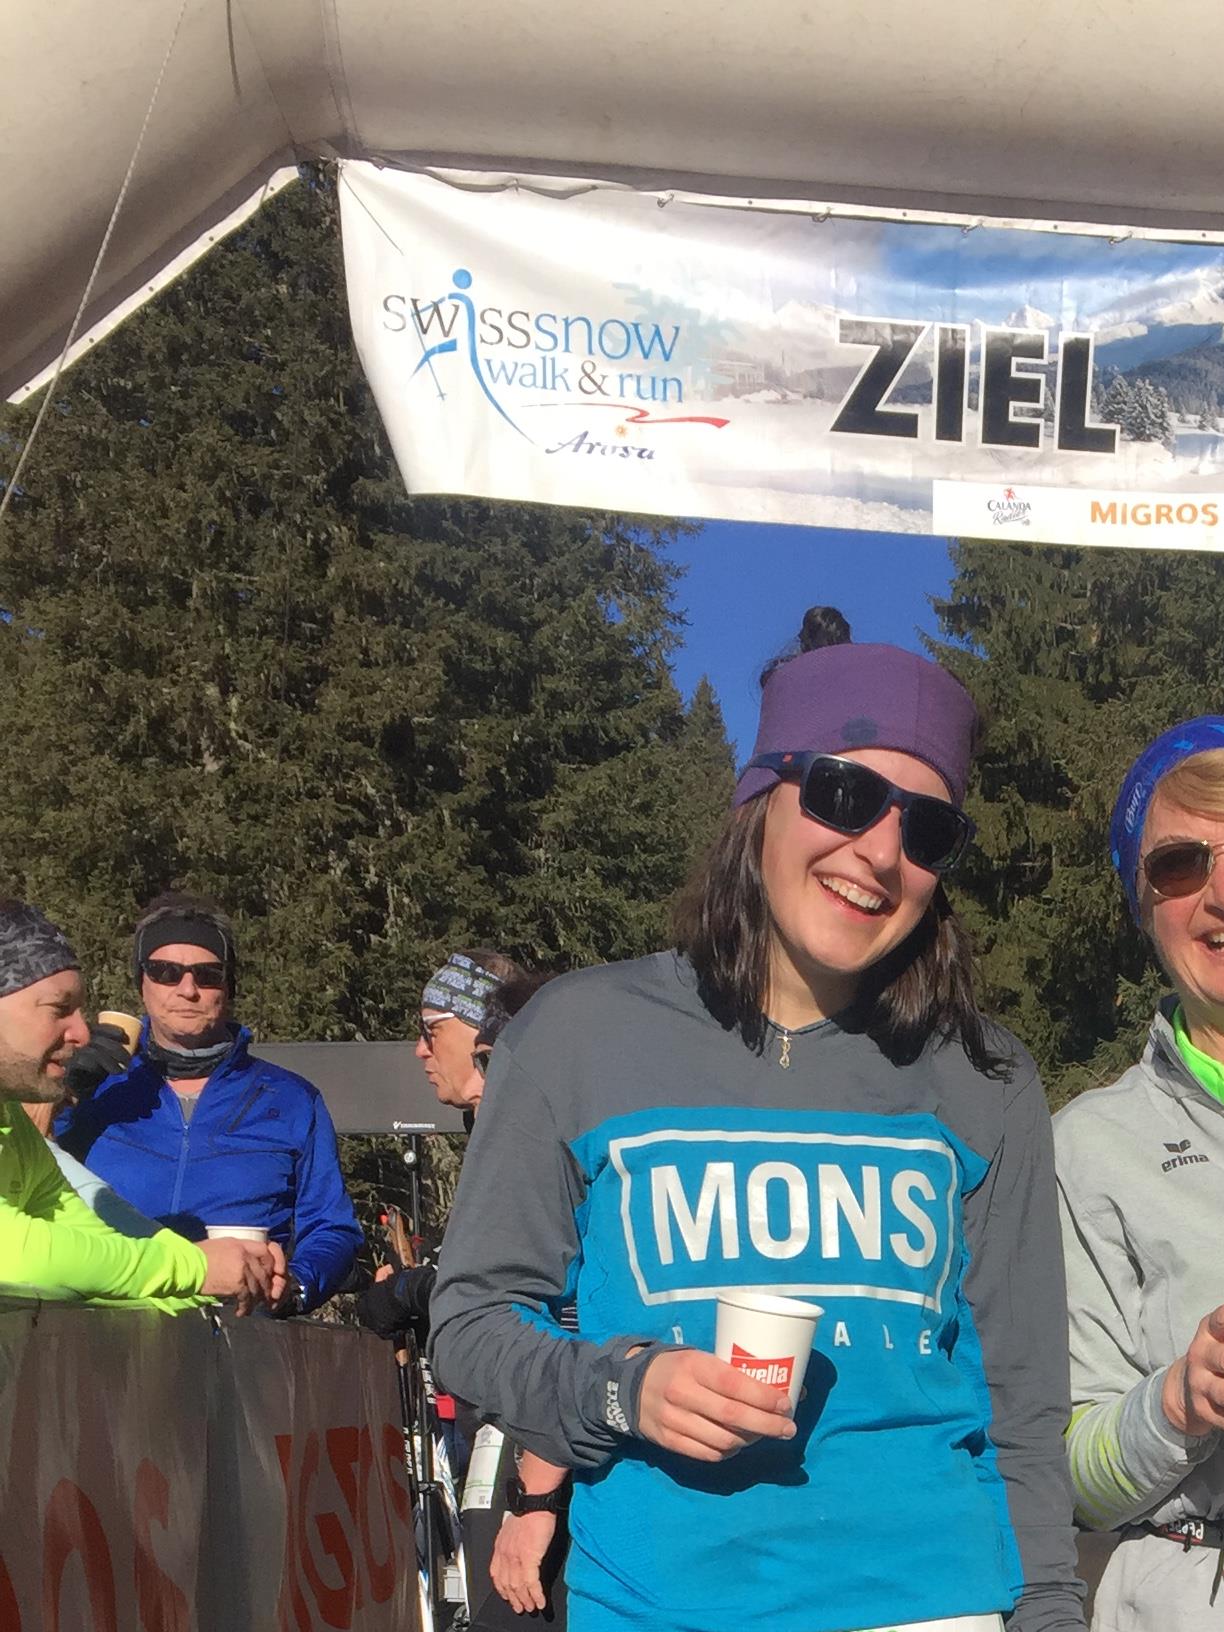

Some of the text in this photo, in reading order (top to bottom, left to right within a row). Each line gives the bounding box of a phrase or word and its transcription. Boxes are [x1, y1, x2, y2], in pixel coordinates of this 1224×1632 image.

[483, 354, 684, 403] walk & run
[829, 315, 1121, 454] ZIEL
[545, 430, 656, 461] Arosa
[987, 499, 1031, 511] CALANDA
[1090, 501, 1219, 527] MIGROS
[1161, 1154, 1210, 1172] erima
[651, 1161, 937, 1269] MONS
[738, 1363, 789, 1385] ivella
